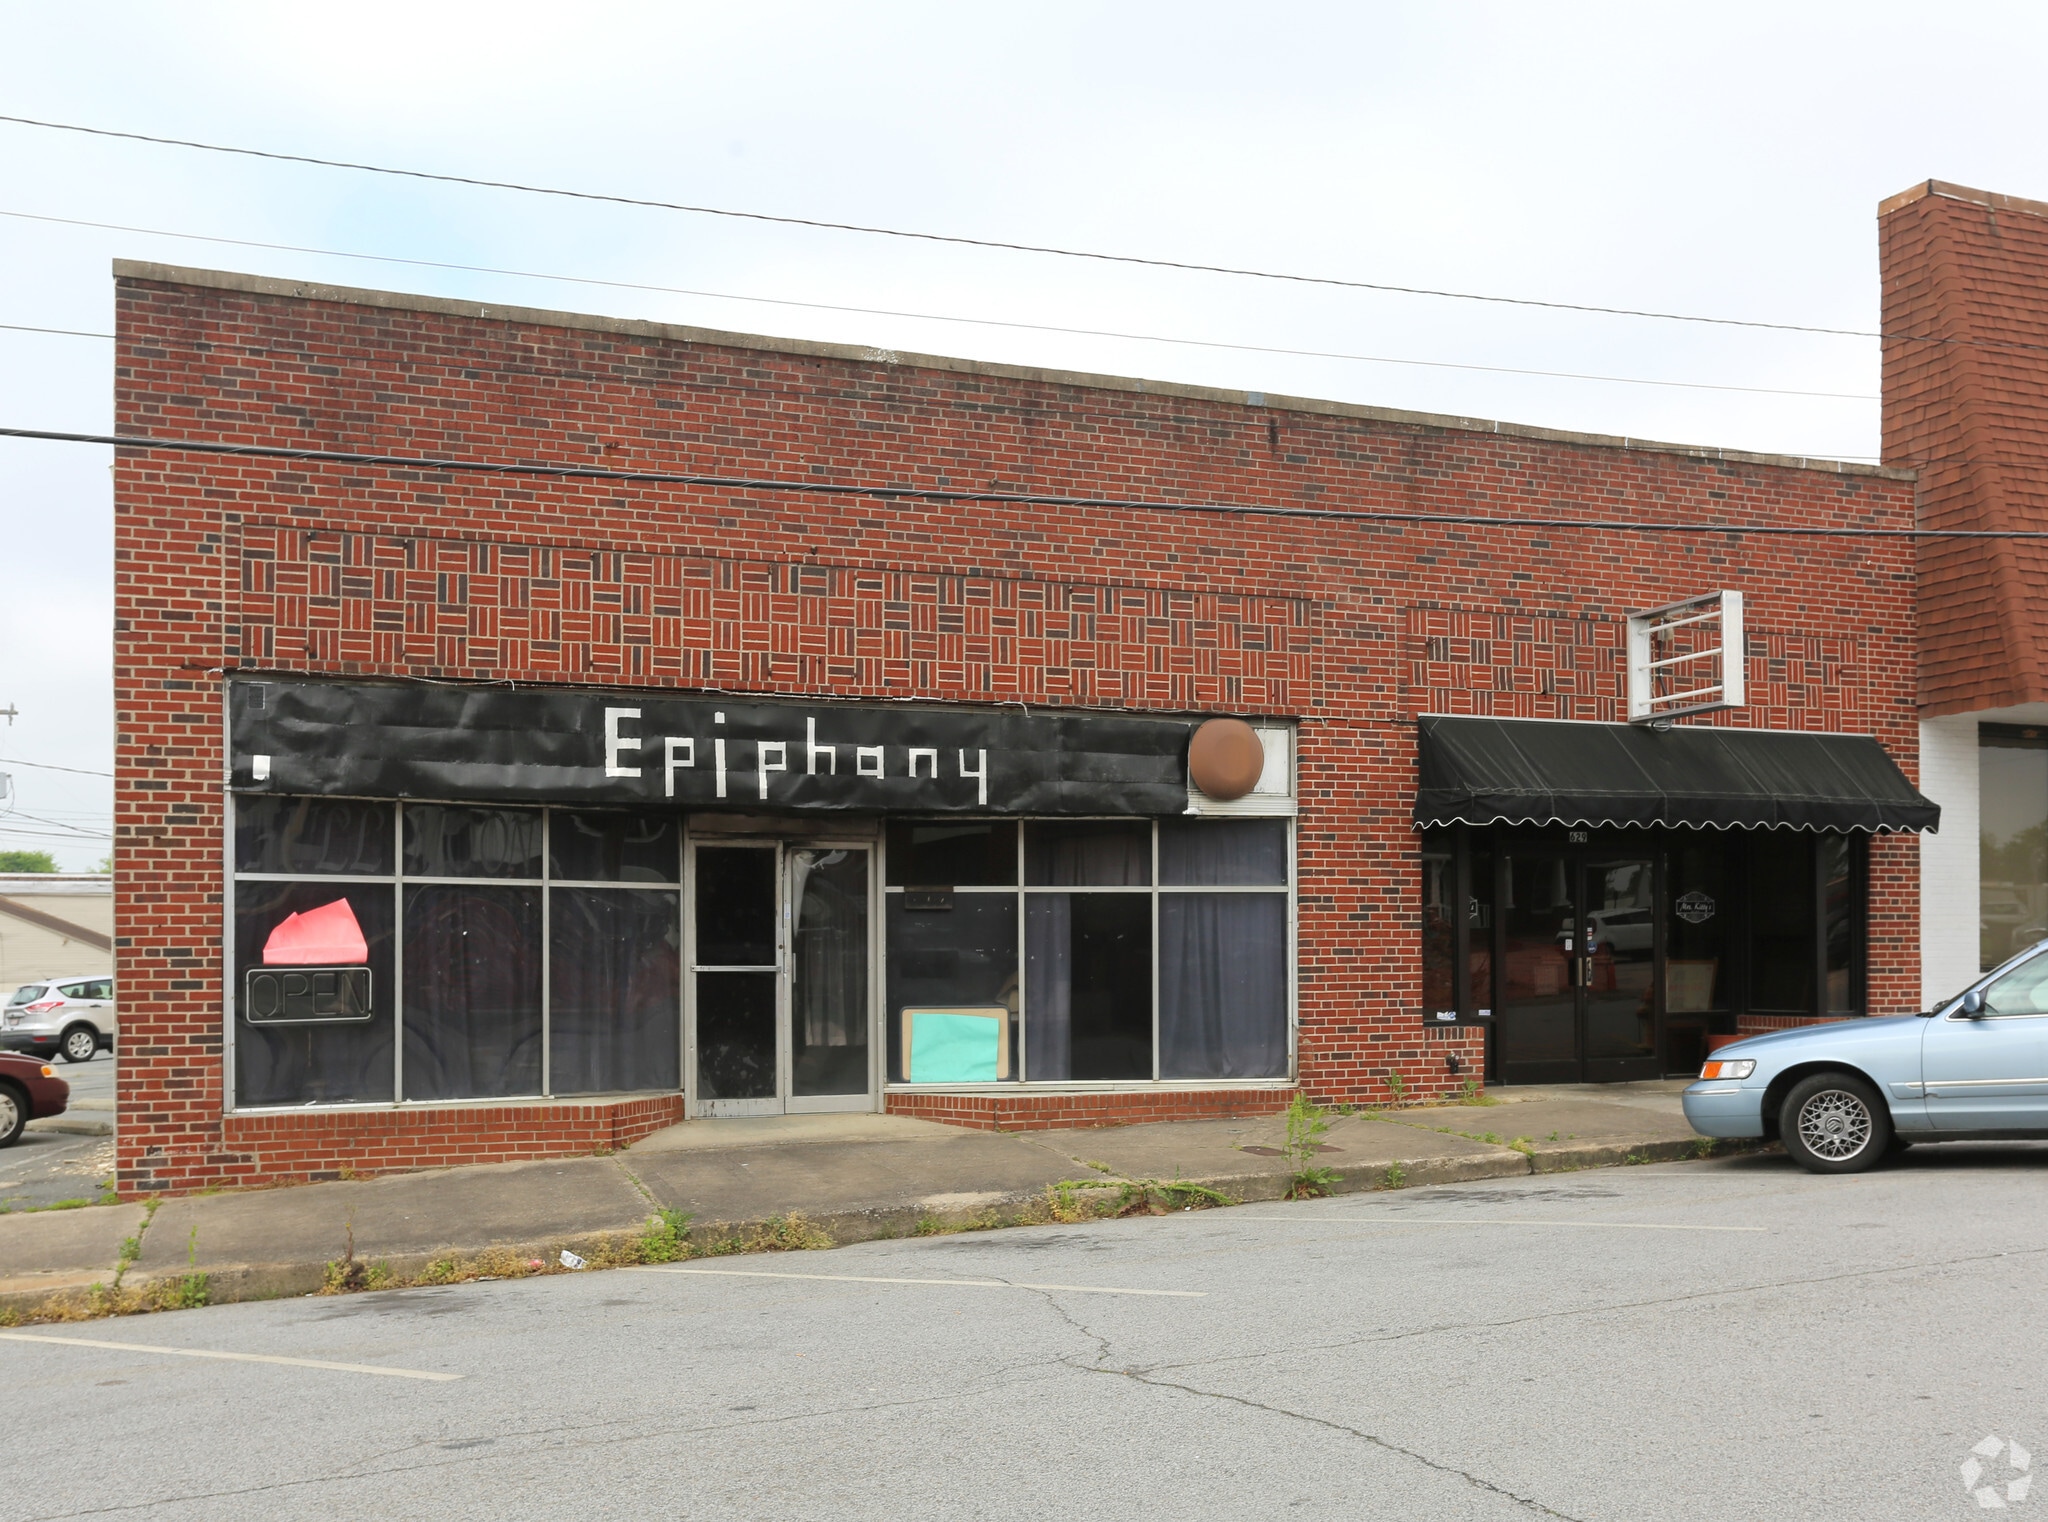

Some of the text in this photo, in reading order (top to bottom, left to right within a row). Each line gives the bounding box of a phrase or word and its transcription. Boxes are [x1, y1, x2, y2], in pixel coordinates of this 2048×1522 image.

[605, 707, 987, 805] Epiphany
[1570, 832, 1587, 842] 629
[251, 973, 366, 1017] OPEN
